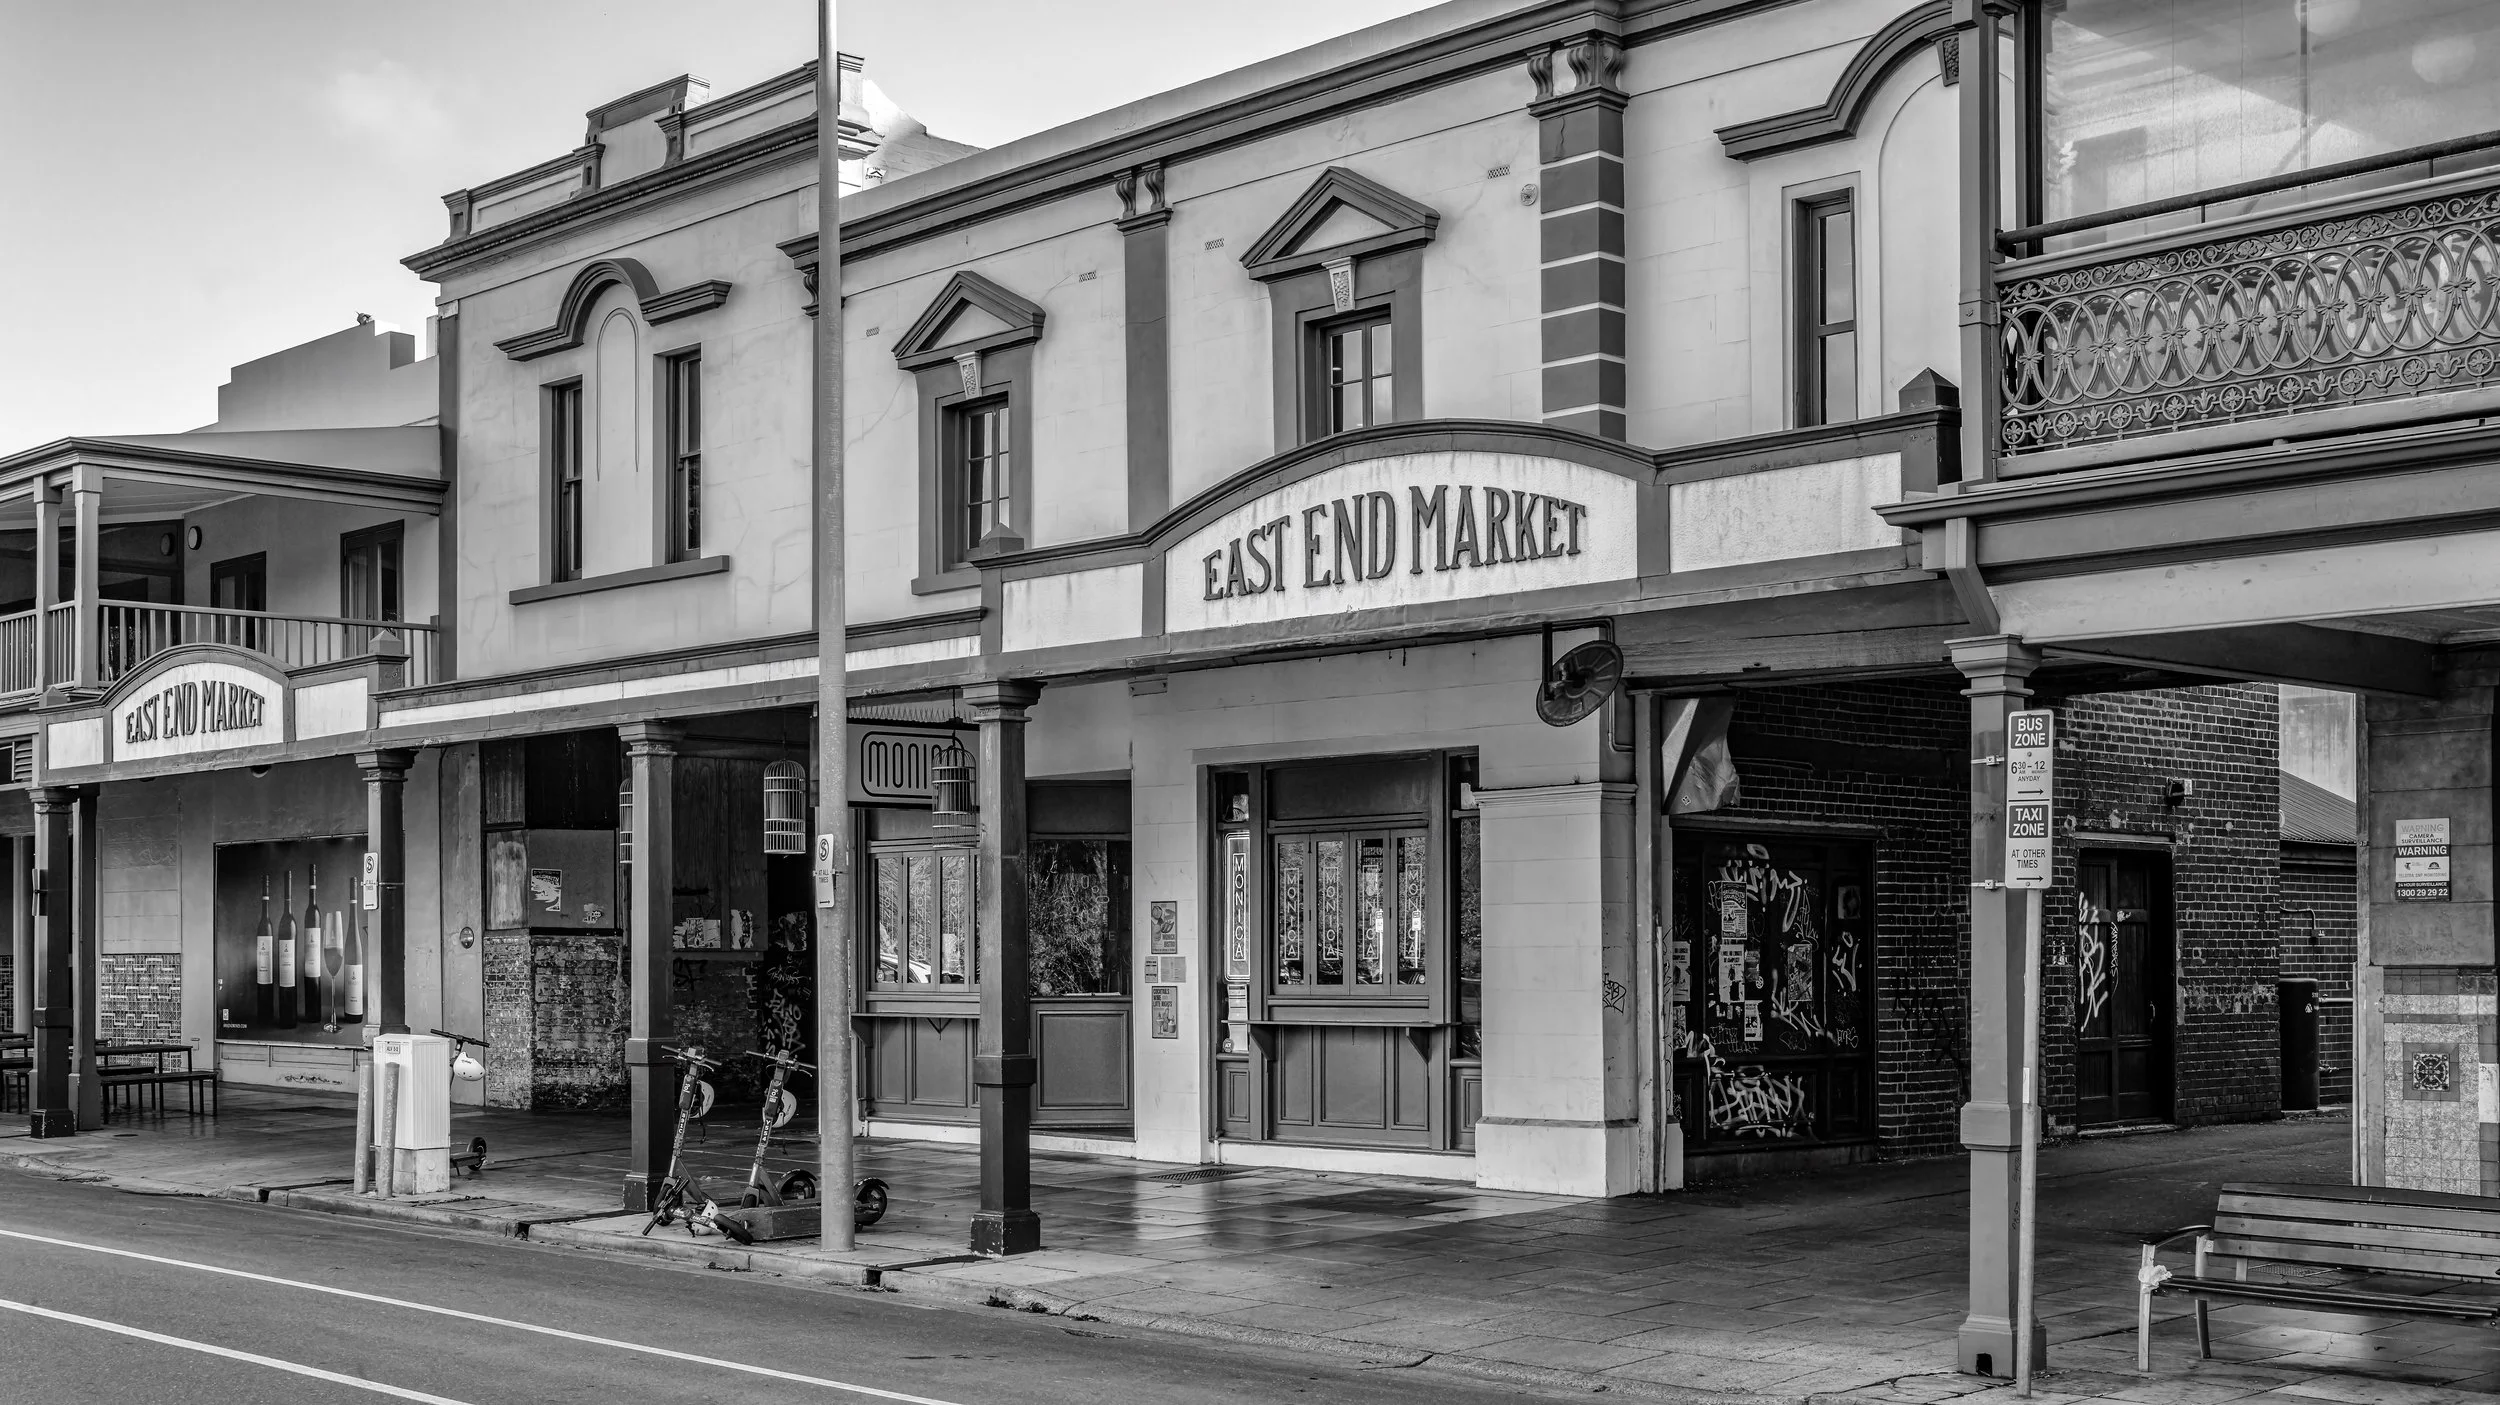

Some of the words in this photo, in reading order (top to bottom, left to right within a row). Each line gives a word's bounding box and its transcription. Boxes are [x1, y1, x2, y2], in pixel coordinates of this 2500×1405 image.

[1202, 516, 1291, 602] EAST
[1302, 490, 1397, 589] END
[1408, 484, 1588, 575] MARKET
[125, 693, 160, 744] EAST
[162, 681, 198, 739] END
[200, 680, 266, 734] MARKET
[2018, 717, 2043, 732] BUS
[2014, 732, 2046, 747] ZONE
[2015, 807, 2043, 822] TAXI
[2012, 822, 2045, 837] ZONE
[2401, 823, 2445, 833] WARNING
[2011, 849, 2020, 858] AT
[2022, 849, 2046, 858] OTHER
[2397, 845, 2448, 856] WARNING
[2017, 860, 2039, 869] TIMES
[2397, 889, 2416, 897] 1300
[2416, 889, 2427, 897] 29
[2427, 888, 2438, 896] 29
[2438, 888, 2448, 896] 22
[1235, 857, 1244, 957] MONICA
[1287, 873, 1297, 956] MONICA
[1326, 872, 1336, 956] MONICA
